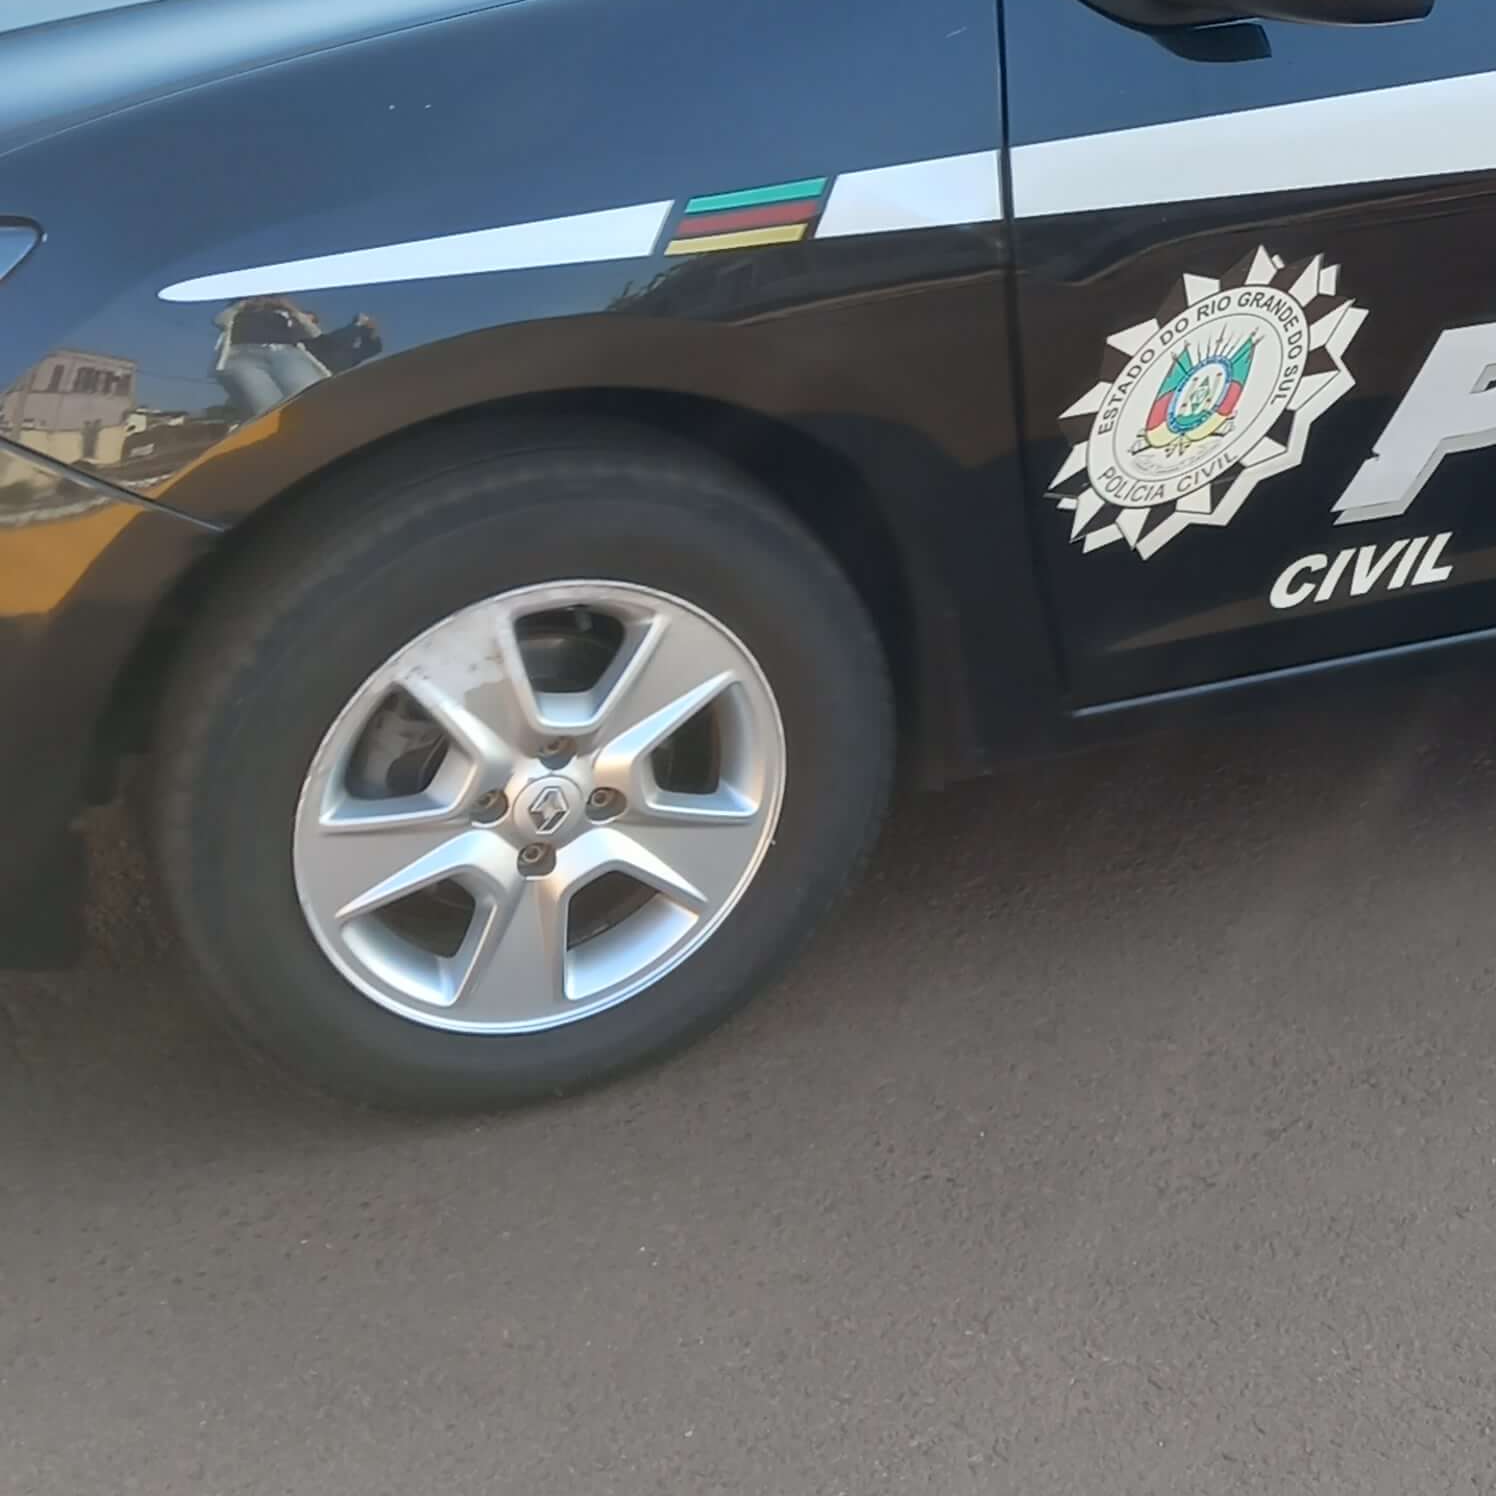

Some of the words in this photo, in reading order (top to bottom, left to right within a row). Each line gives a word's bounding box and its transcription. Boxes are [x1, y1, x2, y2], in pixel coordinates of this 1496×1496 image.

[1196, 295, 1231, 322] RIO
[1237, 291, 1299, 332] GRANDE
[1159, 318, 1190, 347] DO
[1287, 333, 1304, 361] DO
[1098, 348, 1155, 435] ESTADO
[1270, 367, 1299, 405] SUL
[1097, 466, 1166, 502] POLÍCIA
[1176, 452, 1238, 494] CIVIL
[1269, 531, 1454, 610] CIVIL
